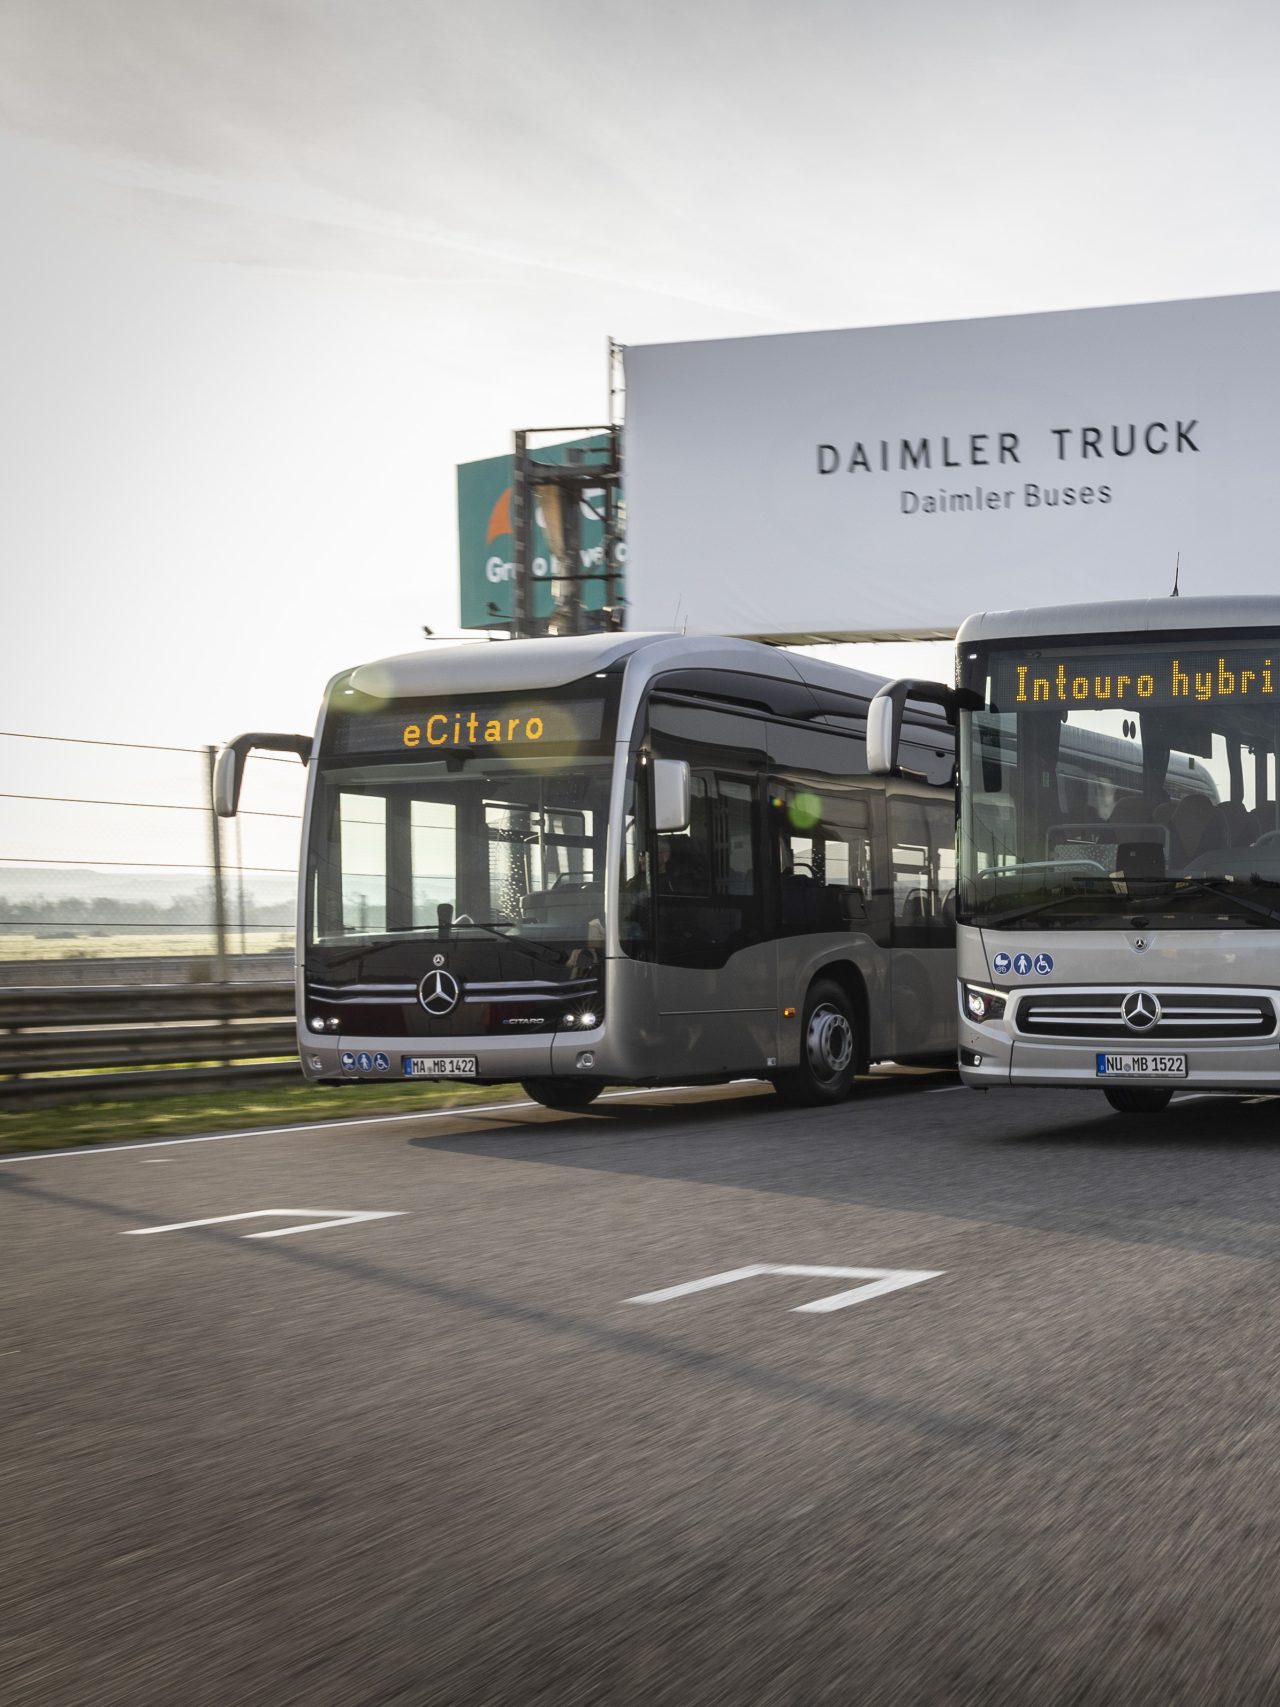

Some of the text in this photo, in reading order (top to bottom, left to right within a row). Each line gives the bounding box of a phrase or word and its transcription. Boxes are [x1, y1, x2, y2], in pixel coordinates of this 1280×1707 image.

[816, 418, 1201, 475] DAIMLER TRUCK
[899, 482, 1113, 515] Daimler Buses
[1015, 664, 1154, 702] Intouro
[402, 711, 545, 748] eCitaro
[412, 1059, 475, 1073] MA MB 1422
[1106, 1056, 1184, 1072] NU MB 1522
